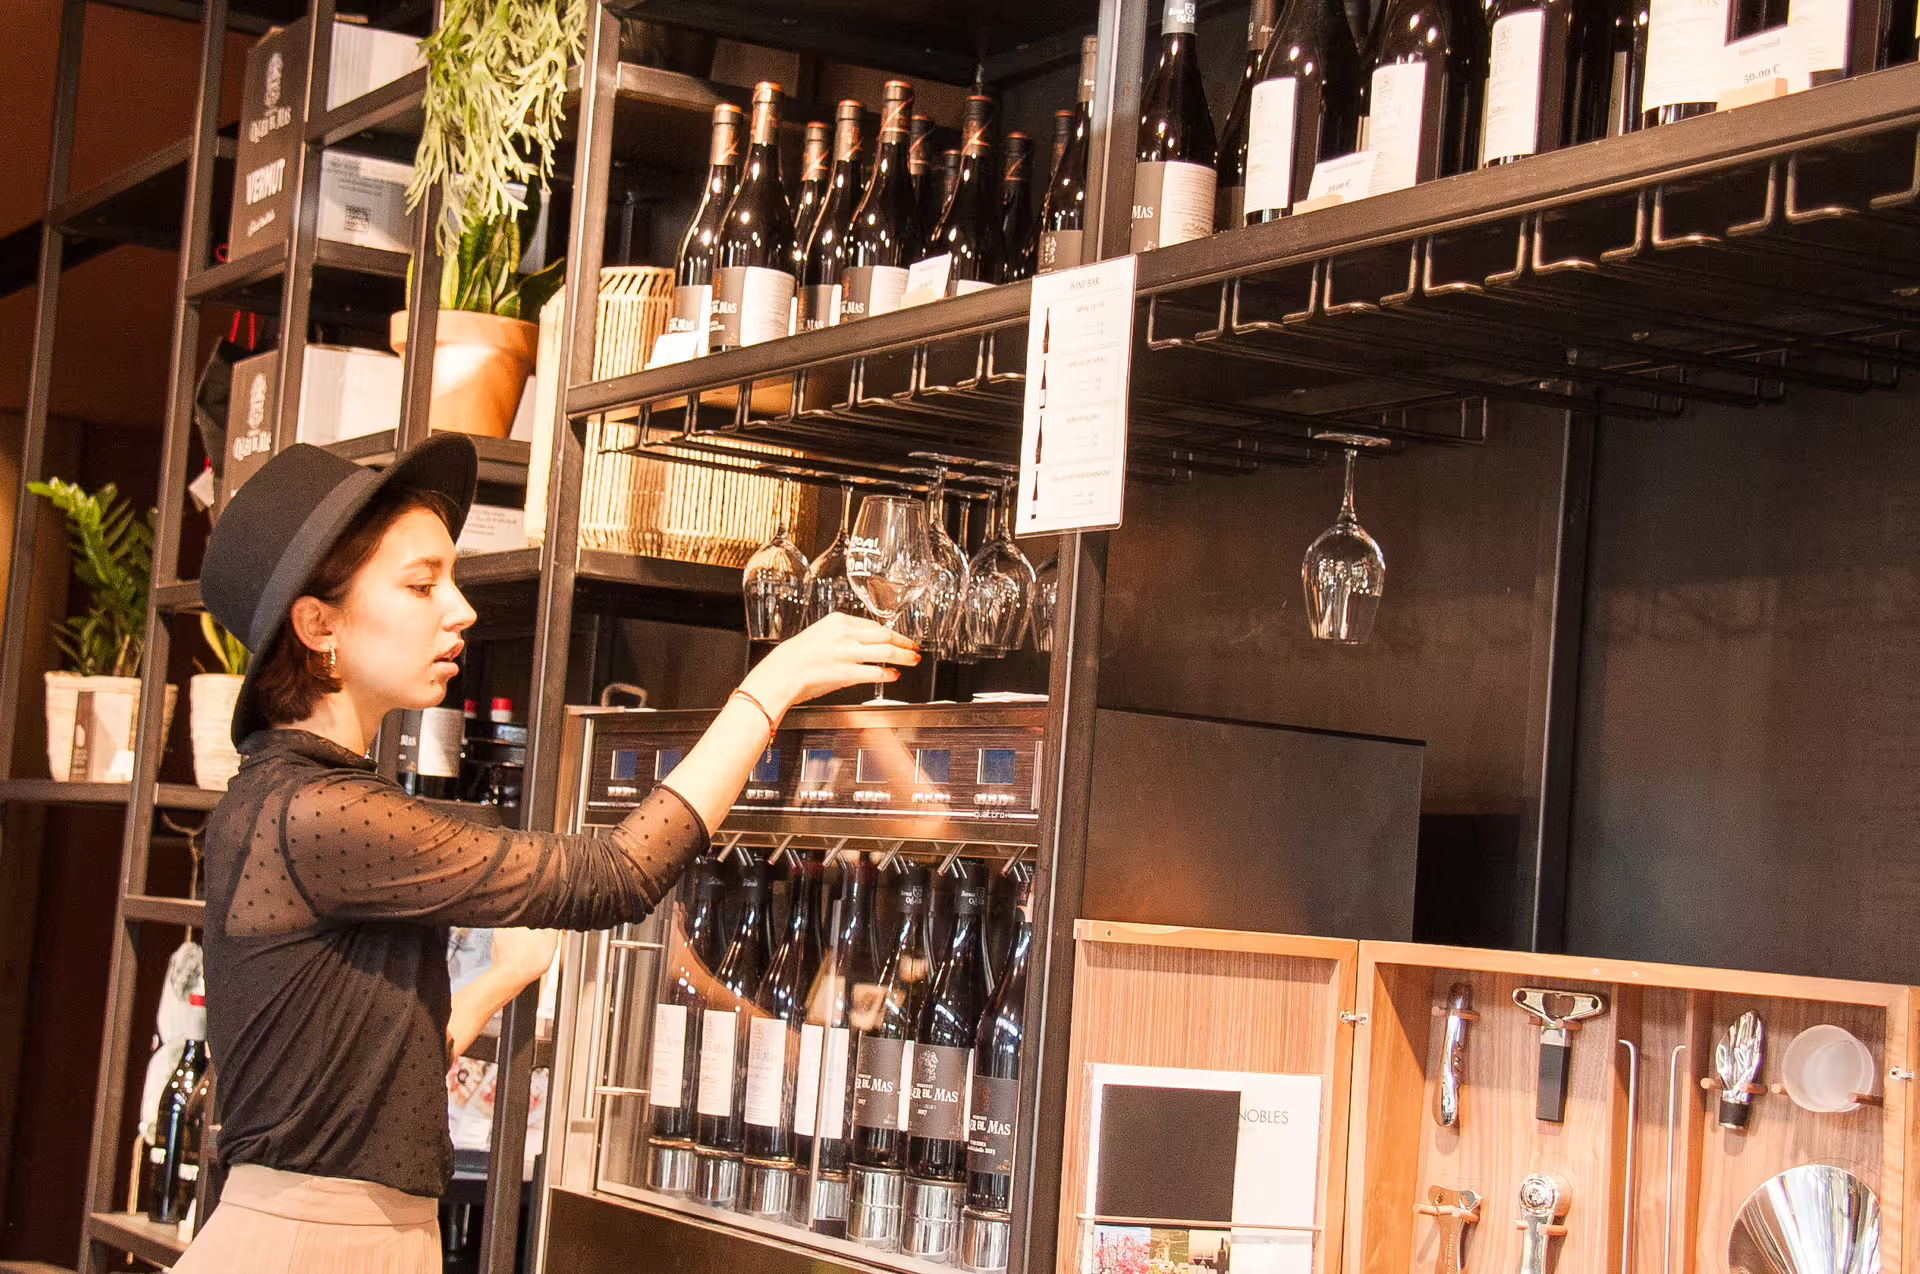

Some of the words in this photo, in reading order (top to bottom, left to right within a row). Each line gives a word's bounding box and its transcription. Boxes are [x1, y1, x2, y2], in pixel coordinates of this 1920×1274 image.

[1131, 204, 1154, 219] MAS
[870, 1078, 894, 1093] MAS
[933, 1088, 959, 1103] MAS
[987, 1120, 1011, 1136] MAS
